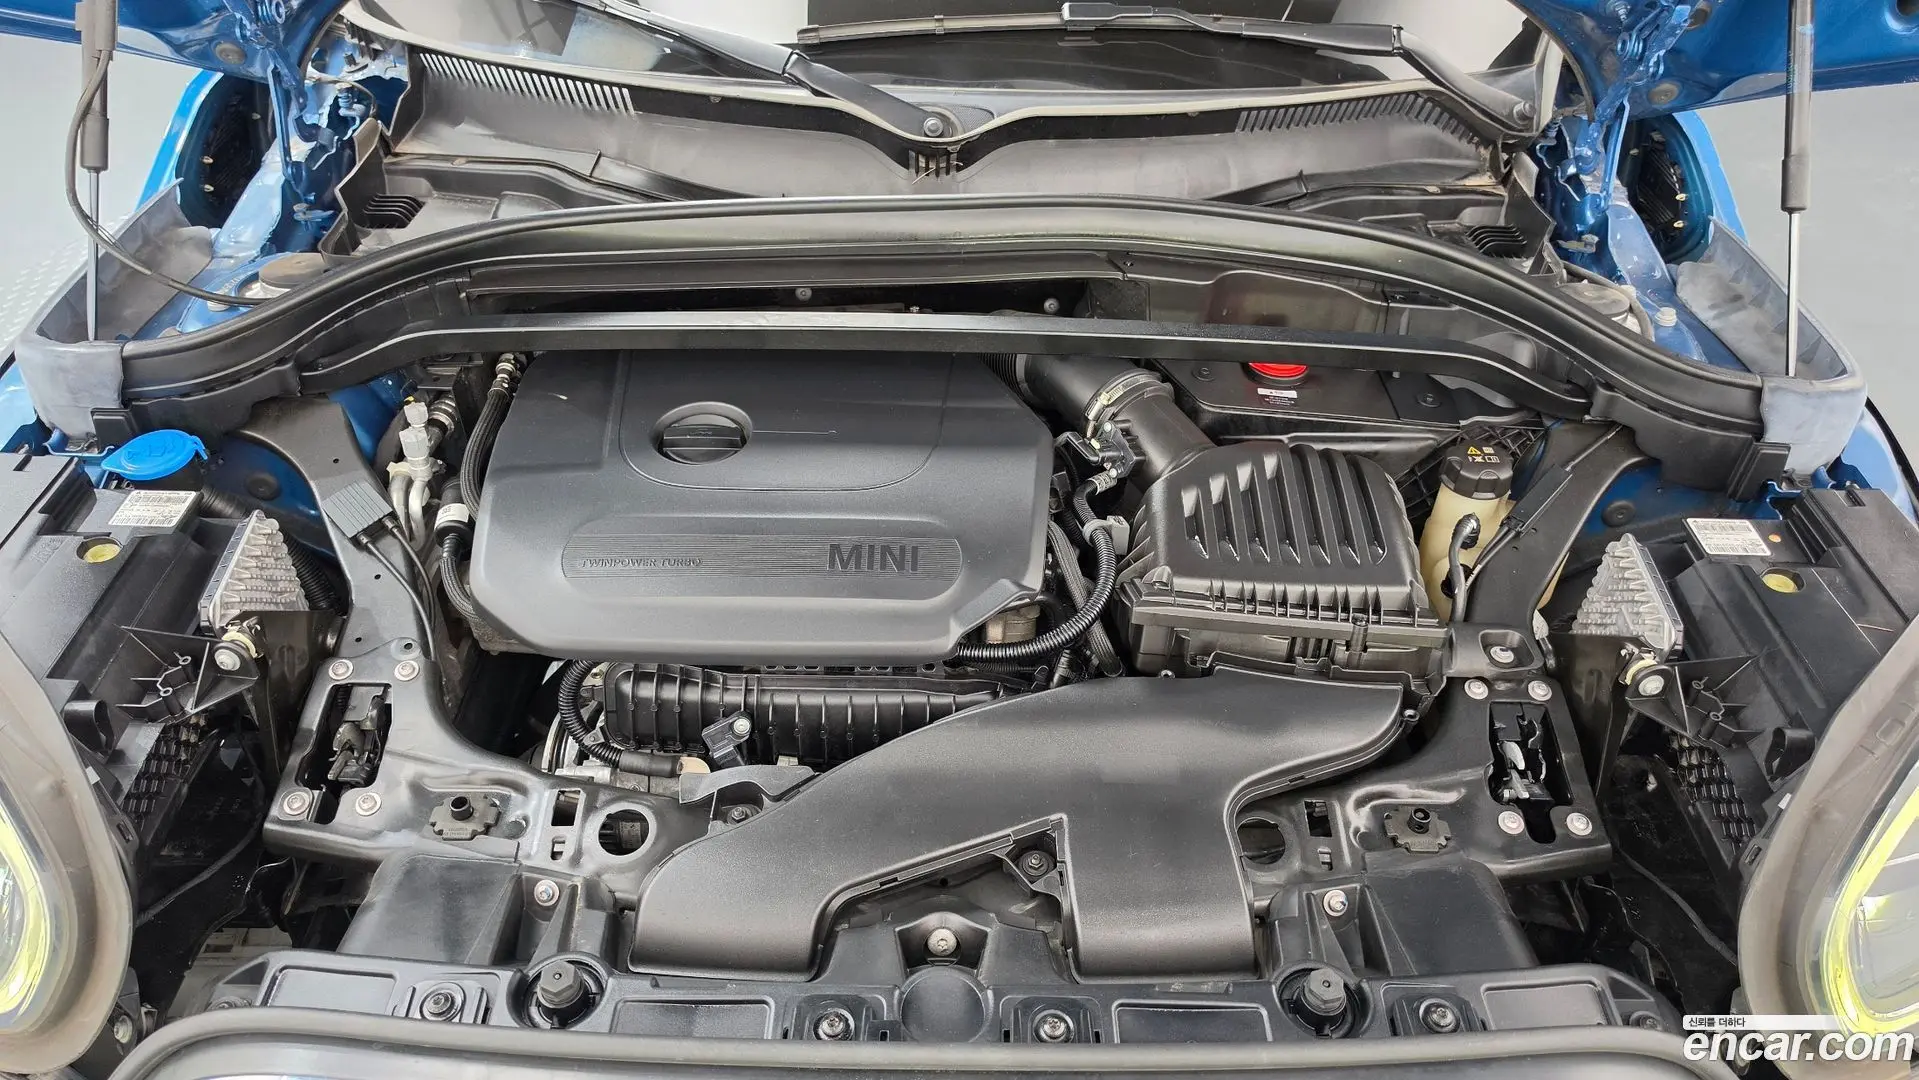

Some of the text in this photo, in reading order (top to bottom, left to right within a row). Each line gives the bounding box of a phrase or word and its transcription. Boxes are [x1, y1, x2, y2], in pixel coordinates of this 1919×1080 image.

[582, 558, 702, 568] TWINPOWER TURBO
[827, 543, 919, 573] MINI
